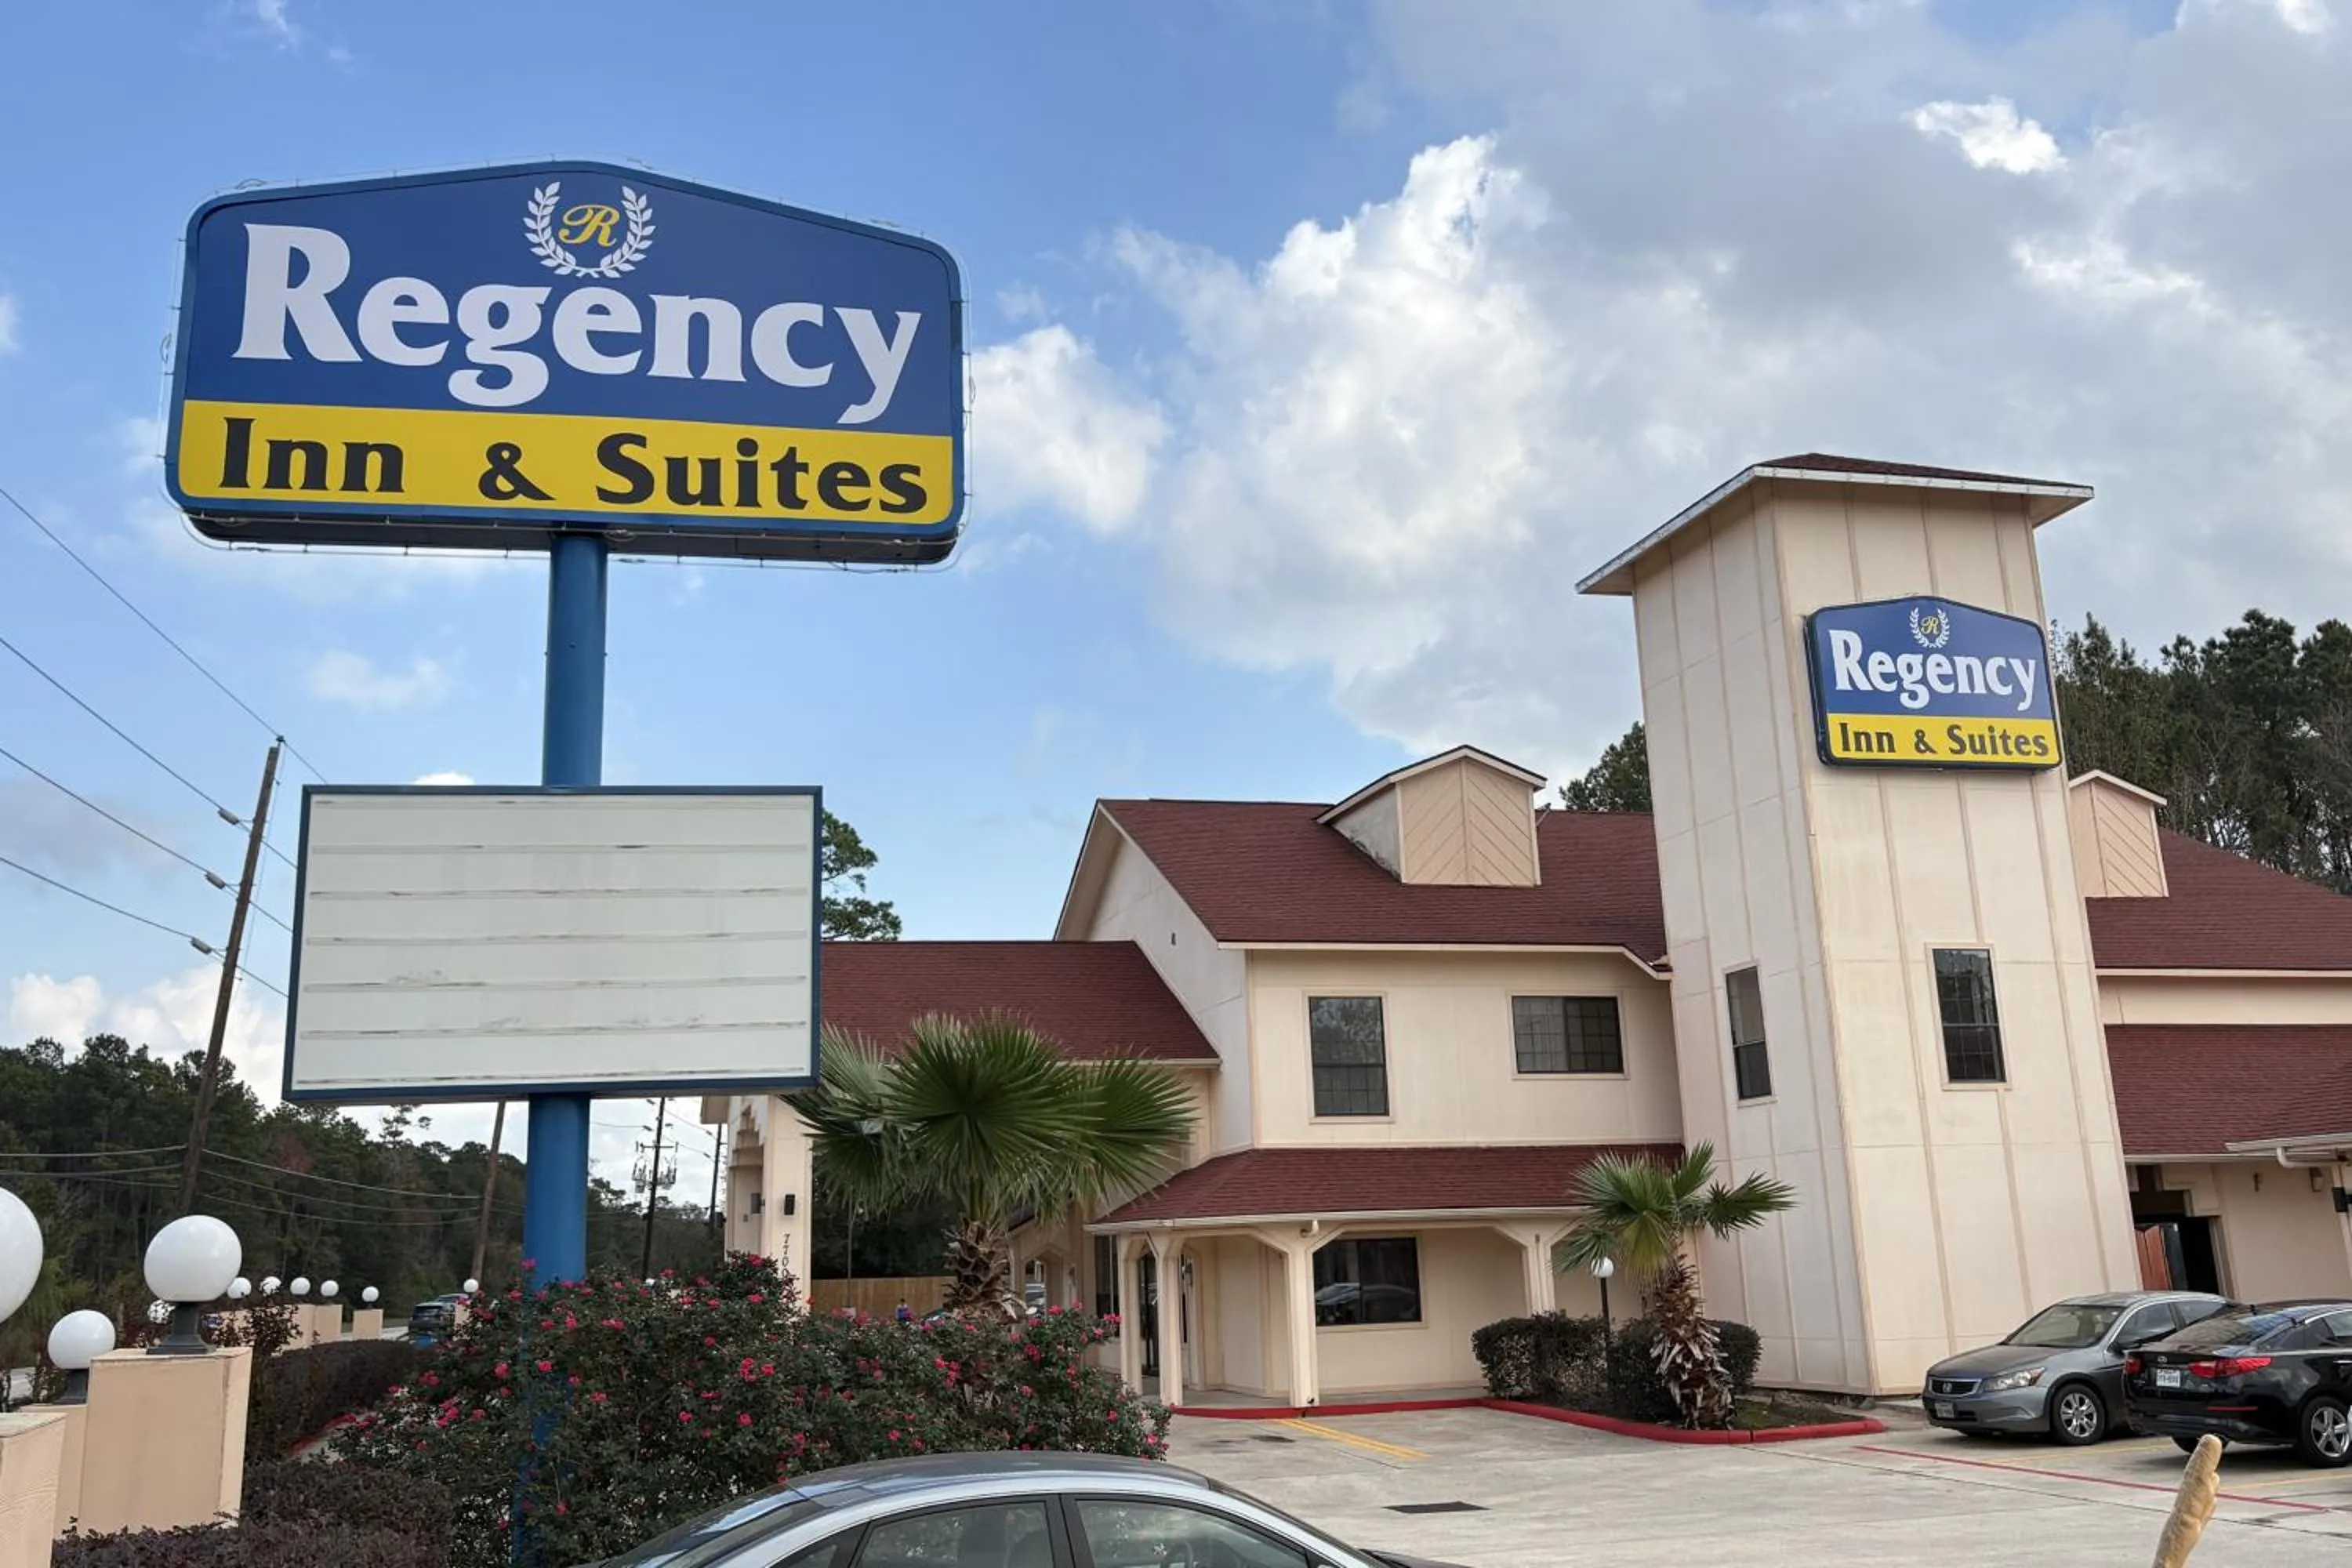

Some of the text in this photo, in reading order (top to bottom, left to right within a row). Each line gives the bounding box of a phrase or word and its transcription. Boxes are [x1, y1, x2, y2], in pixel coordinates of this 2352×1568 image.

[558, 205, 620, 247] R
[232, 222, 922, 424] Regency
[218, 417, 928, 514] Inn & Suites
[1921, 615, 1940, 635] R
[1828, 630, 2036, 712] Regency
[1838, 722, 2049, 757] Inn & Suites
